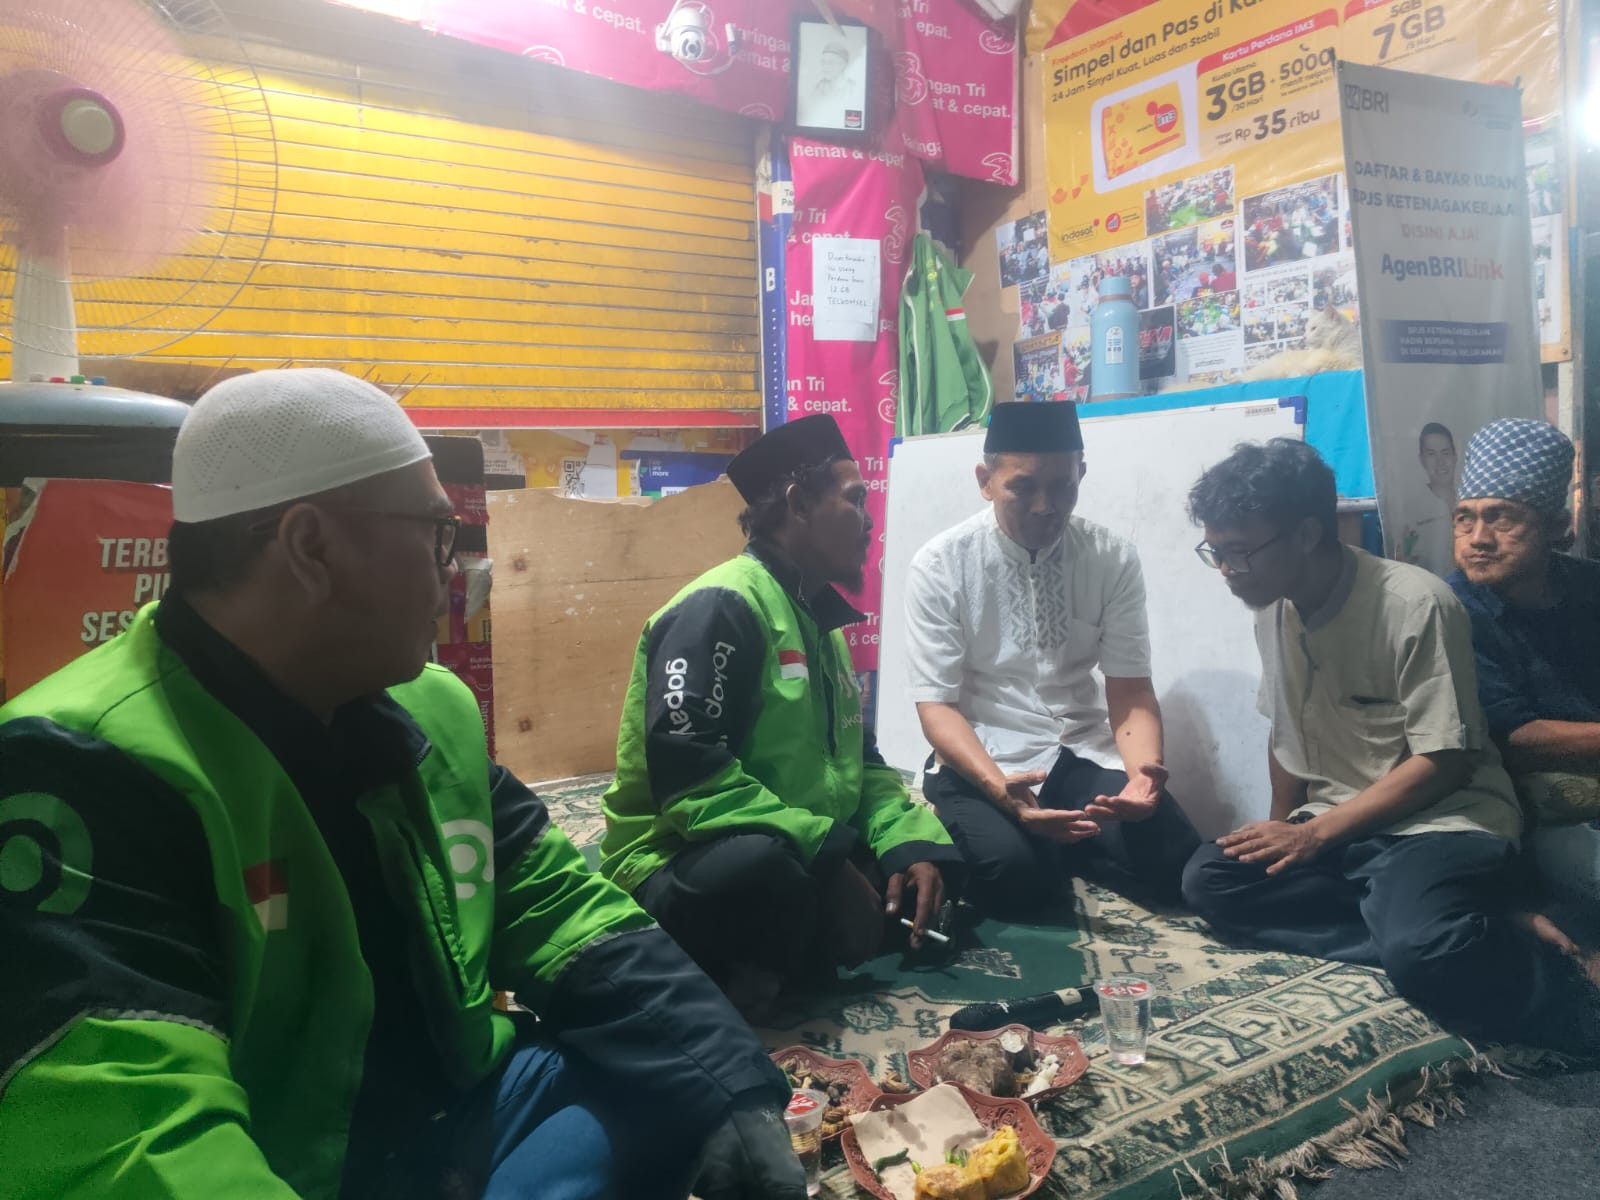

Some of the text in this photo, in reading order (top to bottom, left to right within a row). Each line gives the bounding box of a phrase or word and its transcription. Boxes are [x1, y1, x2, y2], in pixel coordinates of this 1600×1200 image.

[592, 6, 646, 34] cepat.
[916, 22, 953, 39] epat.
[1053, 45, 1114, 87] Simpel
[1119, 37, 1156, 59] dan
[1162, 14, 1199, 42] Pas
[1204, 0, 1223, 24] di
[1222, 46, 1249, 62] Kartu
[1250, 28, 1294, 52] Perdana
[1052, 91, 1064, 103] 24
[1065, 84, 1086, 98] Jam
[1087, 70, 1114, 89] Sinyal
[1143, 51, 1167, 67] Luas
[1167, 42, 1188, 56] dan
[1189, 26, 1220, 47] Stabil
[1279, 47, 1332, 80] 5000
[965, 83, 986, 97] Tri
[1361, 88, 1389, 113] BRI
[947, 99, 958, 113] &
[963, 103, 1011, 119] cepat.
[1235, 128, 1252, 141] Rp
[1253, 108, 1287, 140] 35
[1290, 109, 1320, 128] ribu
[793, 142, 848, 159] hemat
[1354, 160, 1409, 182] DAFTAR
[1411, 167, 1421, 183] &
[1425, 169, 1470, 187] BAYAR
[807, 207, 827, 224] Tri
[1381, 253, 1505, 282] AgenBRILink
[805, 376, 825, 392] Tri
[787, 395, 852, 415] & cepat.
[864, 456, 884, 472] Tri
[98, 536, 170, 569] TERB
[81, 609, 136, 642] SES
[849, 631, 858, 647] &
[663, 657, 697, 736] gopay
